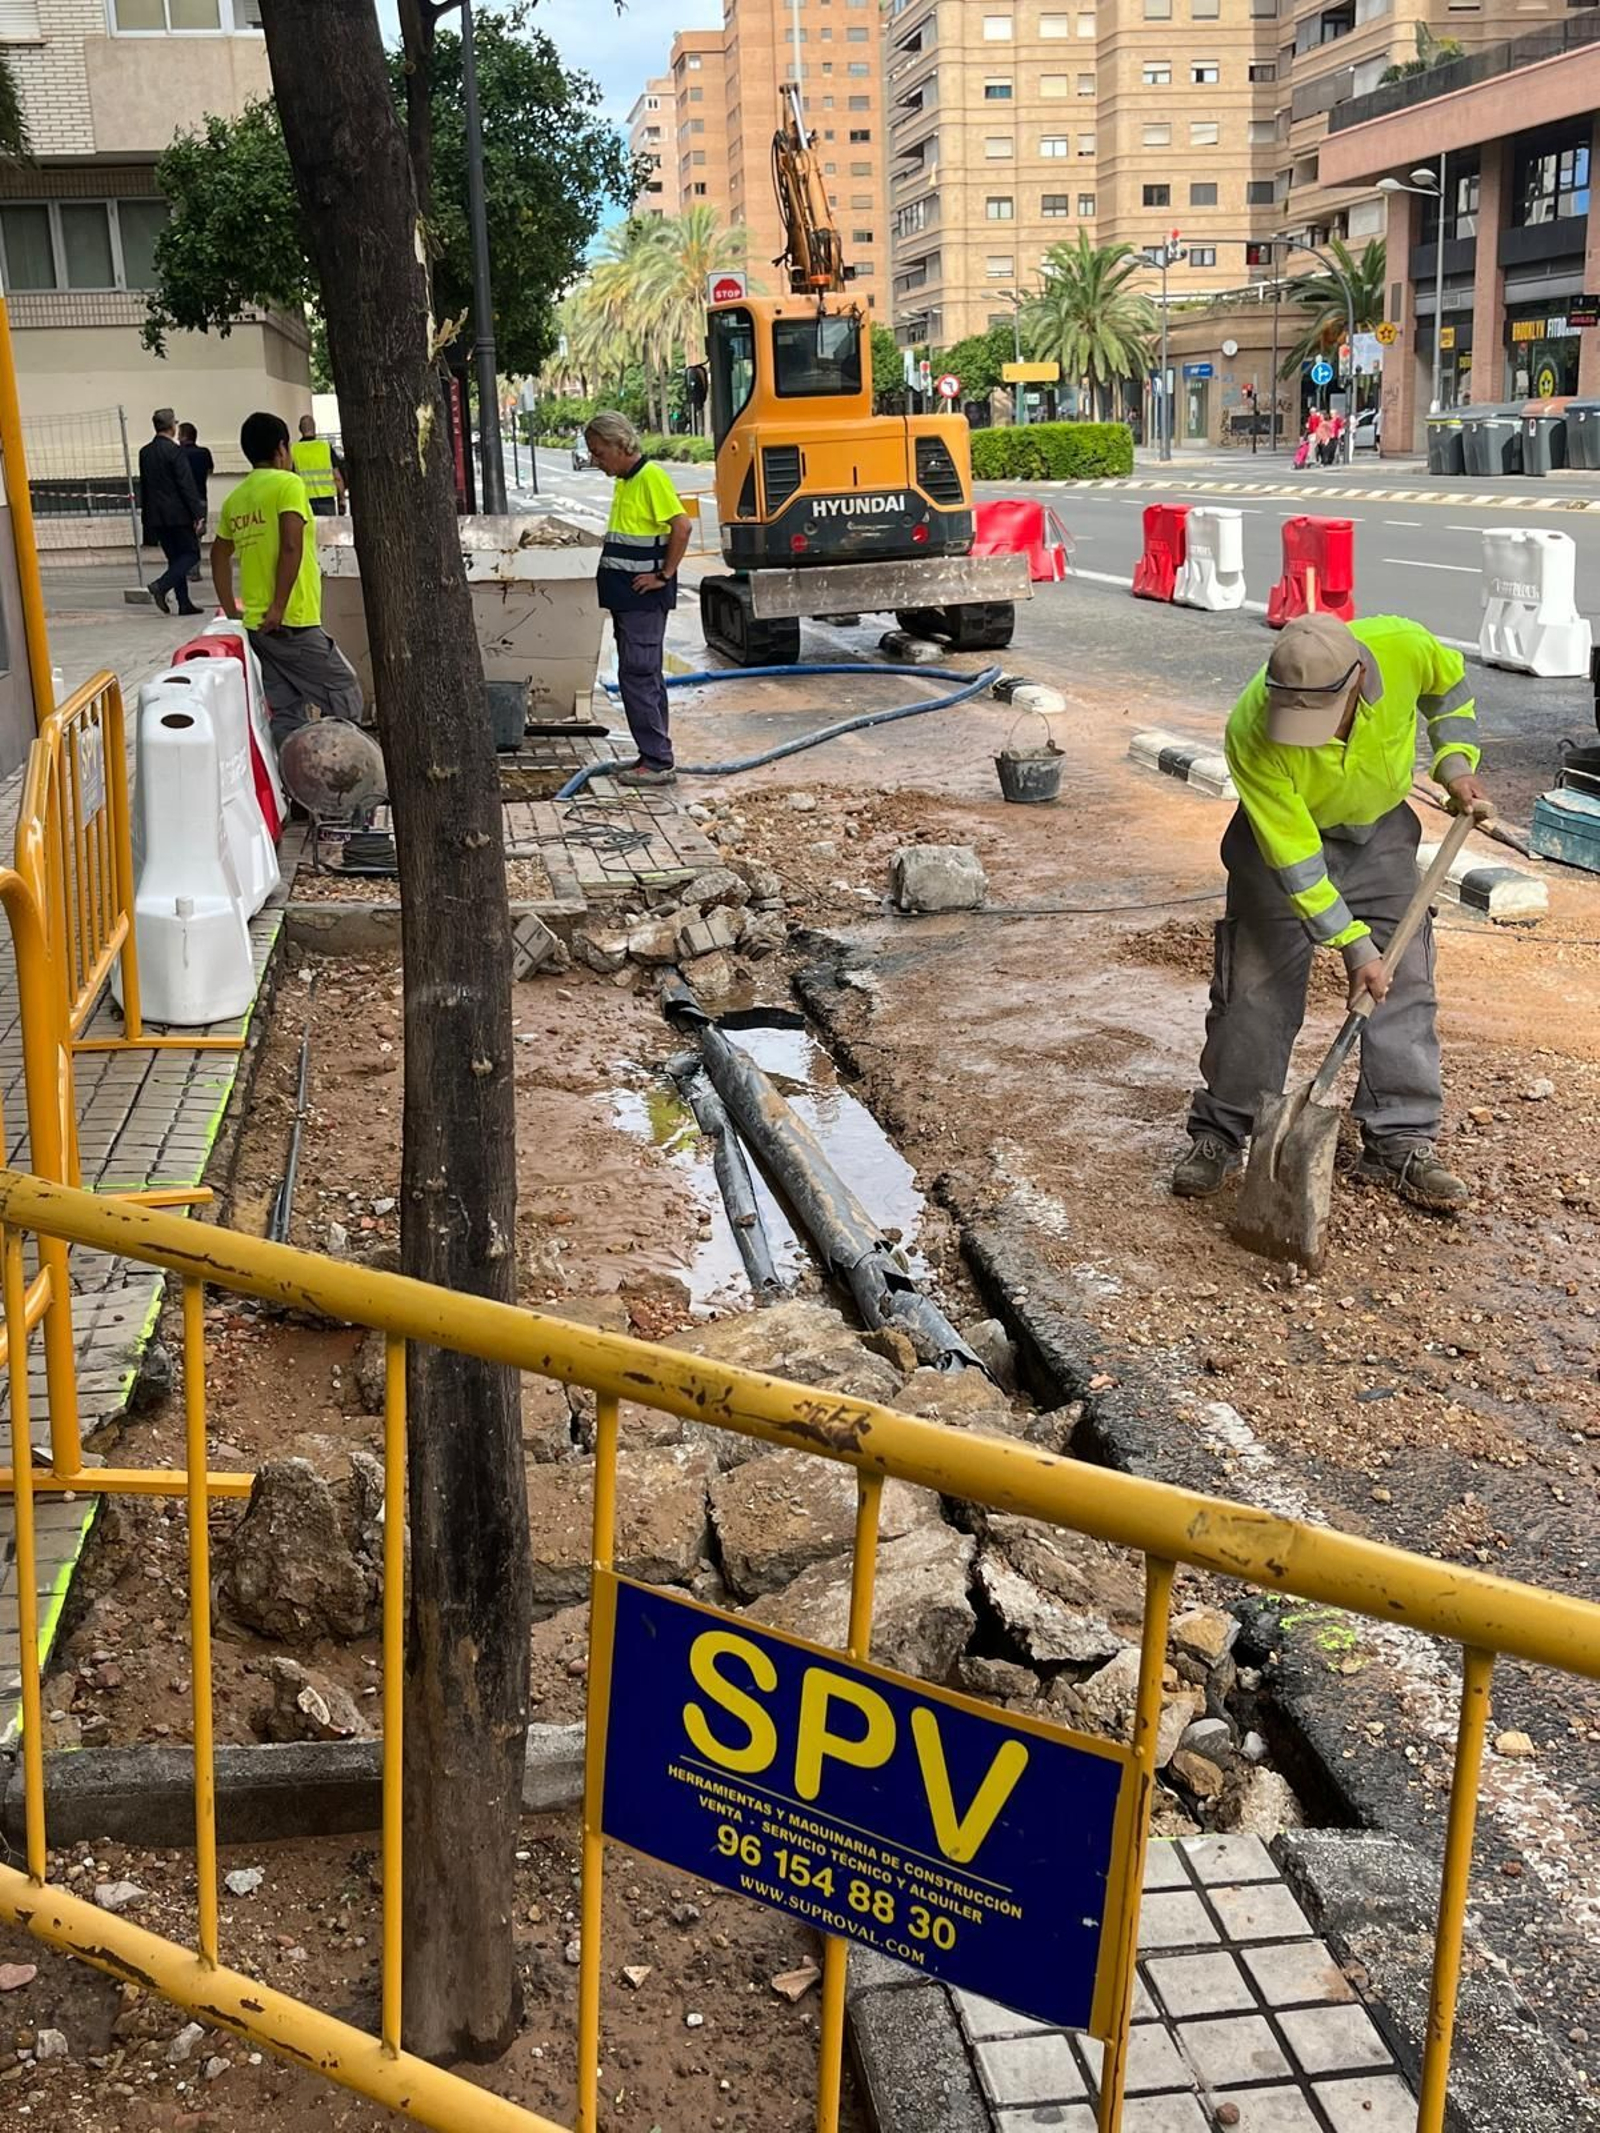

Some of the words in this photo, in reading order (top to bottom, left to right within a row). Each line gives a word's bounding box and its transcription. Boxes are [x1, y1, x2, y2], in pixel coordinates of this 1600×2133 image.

[716, 289, 741, 299] STOP
[812, 495, 905, 517] HYUNDAI
[683, 1630, 1029, 1864] SPV
[668, 1764, 773, 1816] HERRAMIENTAS
[776, 1807, 785, 1820] Y
[788, 1813, 877, 1860] MAQUINARIA
[881, 1852, 900, 1869] DE
[903, 1861, 1022, 1919] CONSTRUCCIÓN
[699, 1794, 743, 1822] VENTA
[761, 1821, 826, 1857] SERVICIO
[830, 1849, 892, 1885] TÉCNICO
[896, 1876, 906, 1890] Y
[909, 1883, 983, 1924] ALQUILER
[716, 1824, 762, 1867] 96
[773, 1849, 835, 1898] 154
[847, 1879, 895, 1925] 88
[907, 1905, 956, 1950] 30
[740, 1873, 925, 1965] WWW.SUPROVAL.COM
